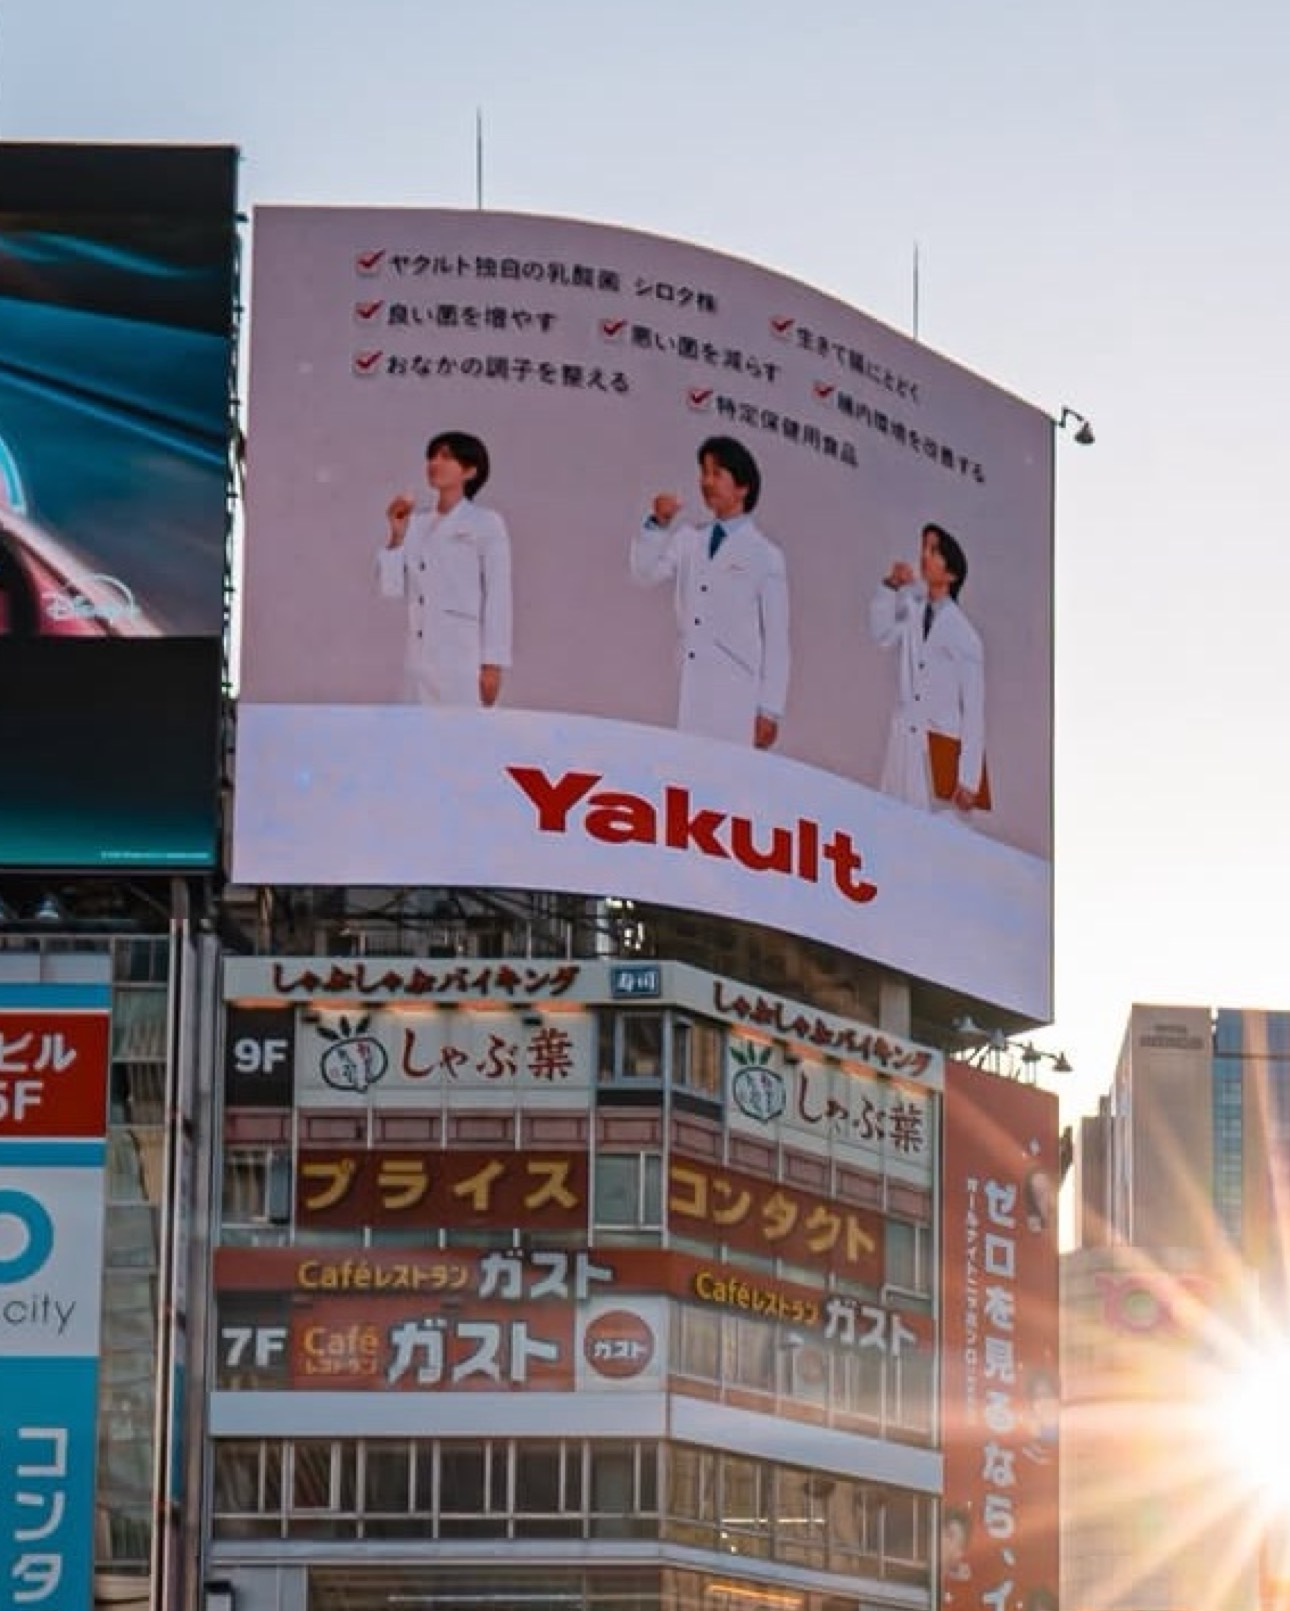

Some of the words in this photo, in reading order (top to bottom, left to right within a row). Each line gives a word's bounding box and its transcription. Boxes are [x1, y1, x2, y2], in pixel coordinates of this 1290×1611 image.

[389, 253, 621, 293] ヤクルト独自の乳酸菌
[634, 277, 717, 313] シロタ株
[388, 302, 556, 333] 良い菌を増やす
[386, 354, 630, 393] おなかの調子を整える
[631, 323, 781, 383] 悪い菌を減らす
[715, 393, 859, 468] 特定保健用食品
[506, 766, 879, 903] Yakult
[234, 1038, 288, 1073] 9F
[402, 1027, 575, 1081] しゃぶ葉
[798, 1070, 925, 1155] しゃぶ葉
[301, 1157, 580, 1210] プライス
[668, 1161, 876, 1264] コンタクト
[477, 1248, 614, 1299] ガスト
[3, 1295, 77, 1336] city
[303, 1322, 379, 1358] Café
[823, 1297, 917, 1357] ガスト
[221, 1326, 289, 1369] 7F
[387, 1317, 560, 1385] ガスト
[593, 1339, 647, 1358] ガスト
